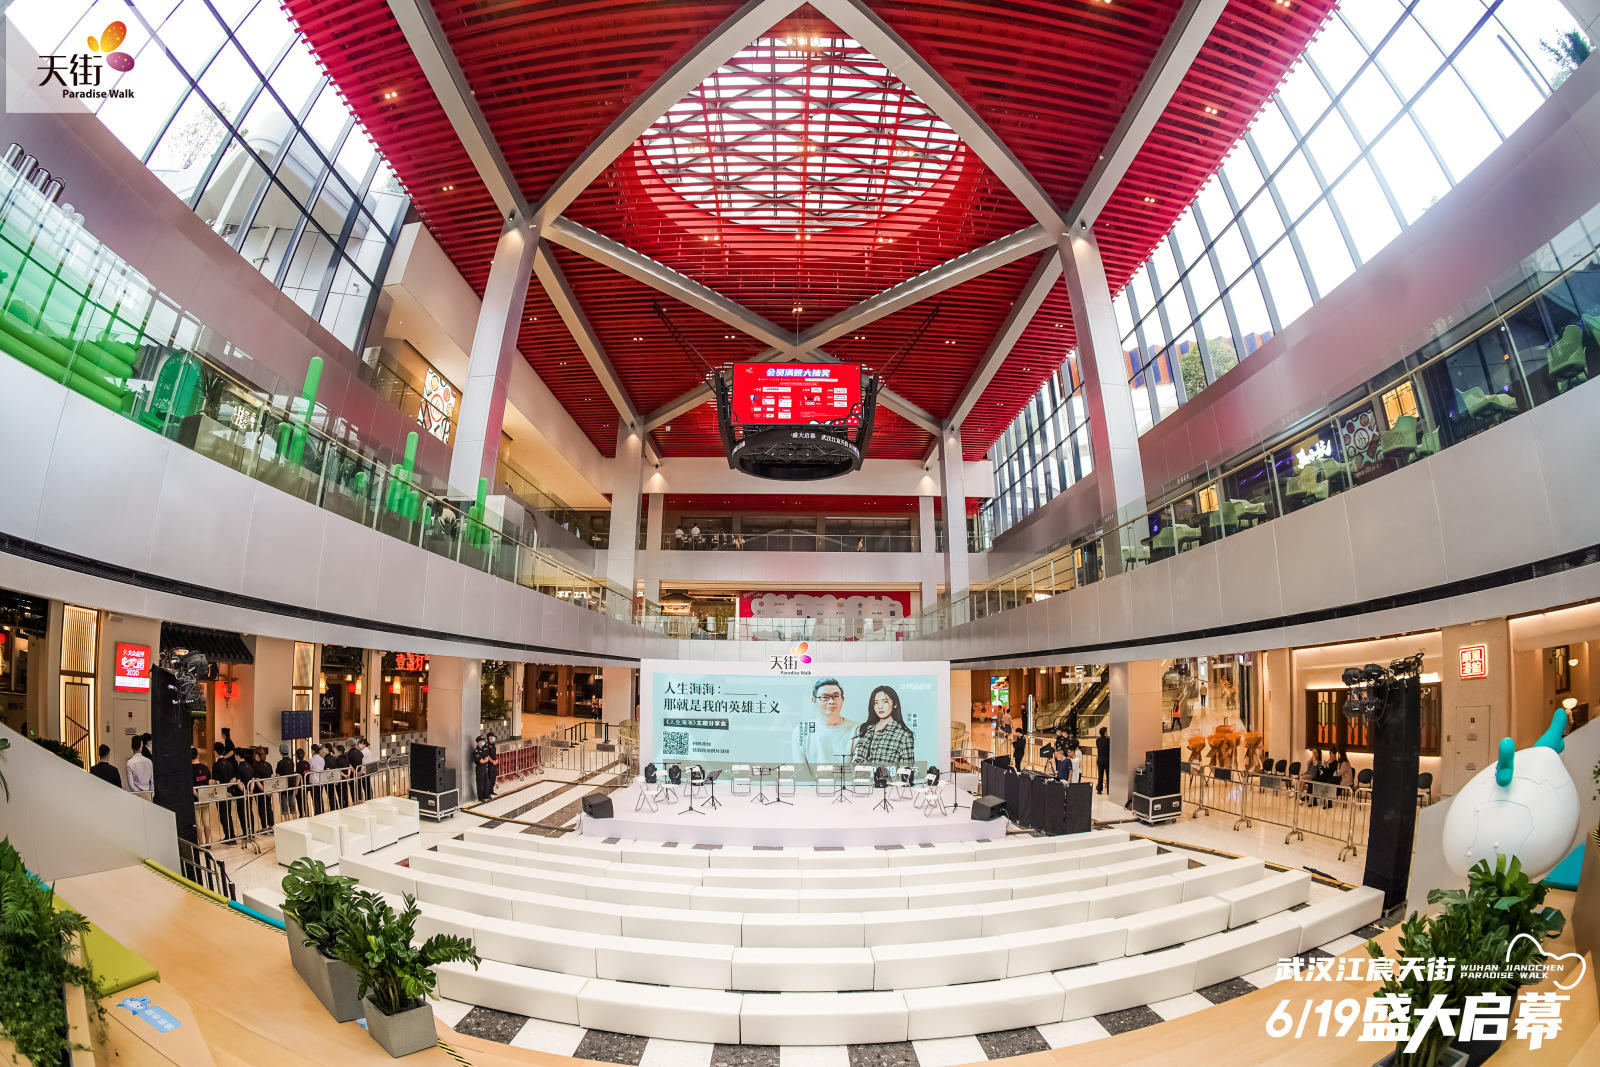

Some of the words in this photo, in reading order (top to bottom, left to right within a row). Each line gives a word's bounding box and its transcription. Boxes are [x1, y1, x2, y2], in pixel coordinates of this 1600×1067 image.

[770, 655, 799, 670] 天街
[663, 698, 780, 714] 那就是我的英雄主义
